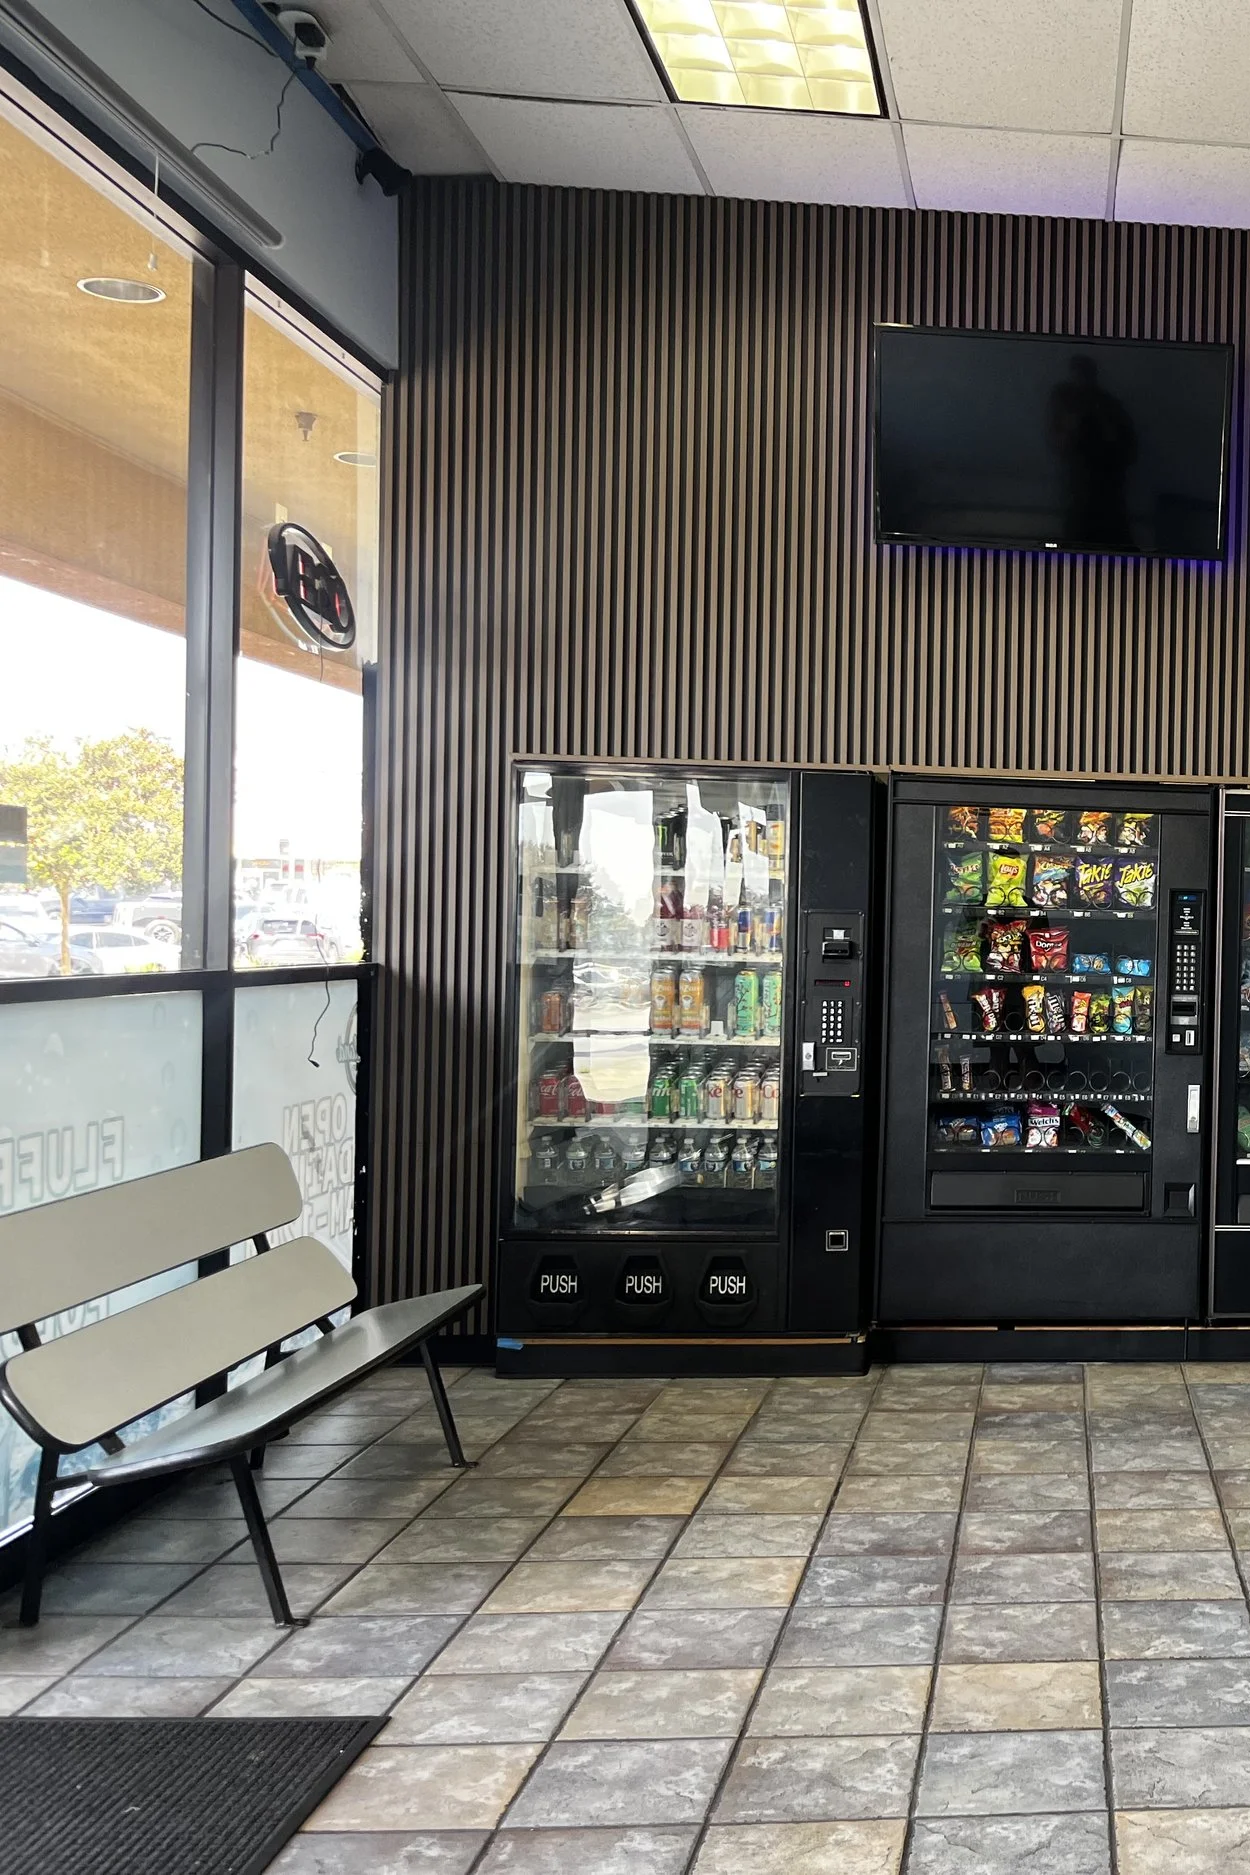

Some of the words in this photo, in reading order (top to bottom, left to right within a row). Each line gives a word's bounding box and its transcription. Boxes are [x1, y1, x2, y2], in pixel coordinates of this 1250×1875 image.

[540, 1275, 578, 1293] PUSH
[626, 1275, 662, 1294] PUSH
[710, 1276, 746, 1294] PUSH
